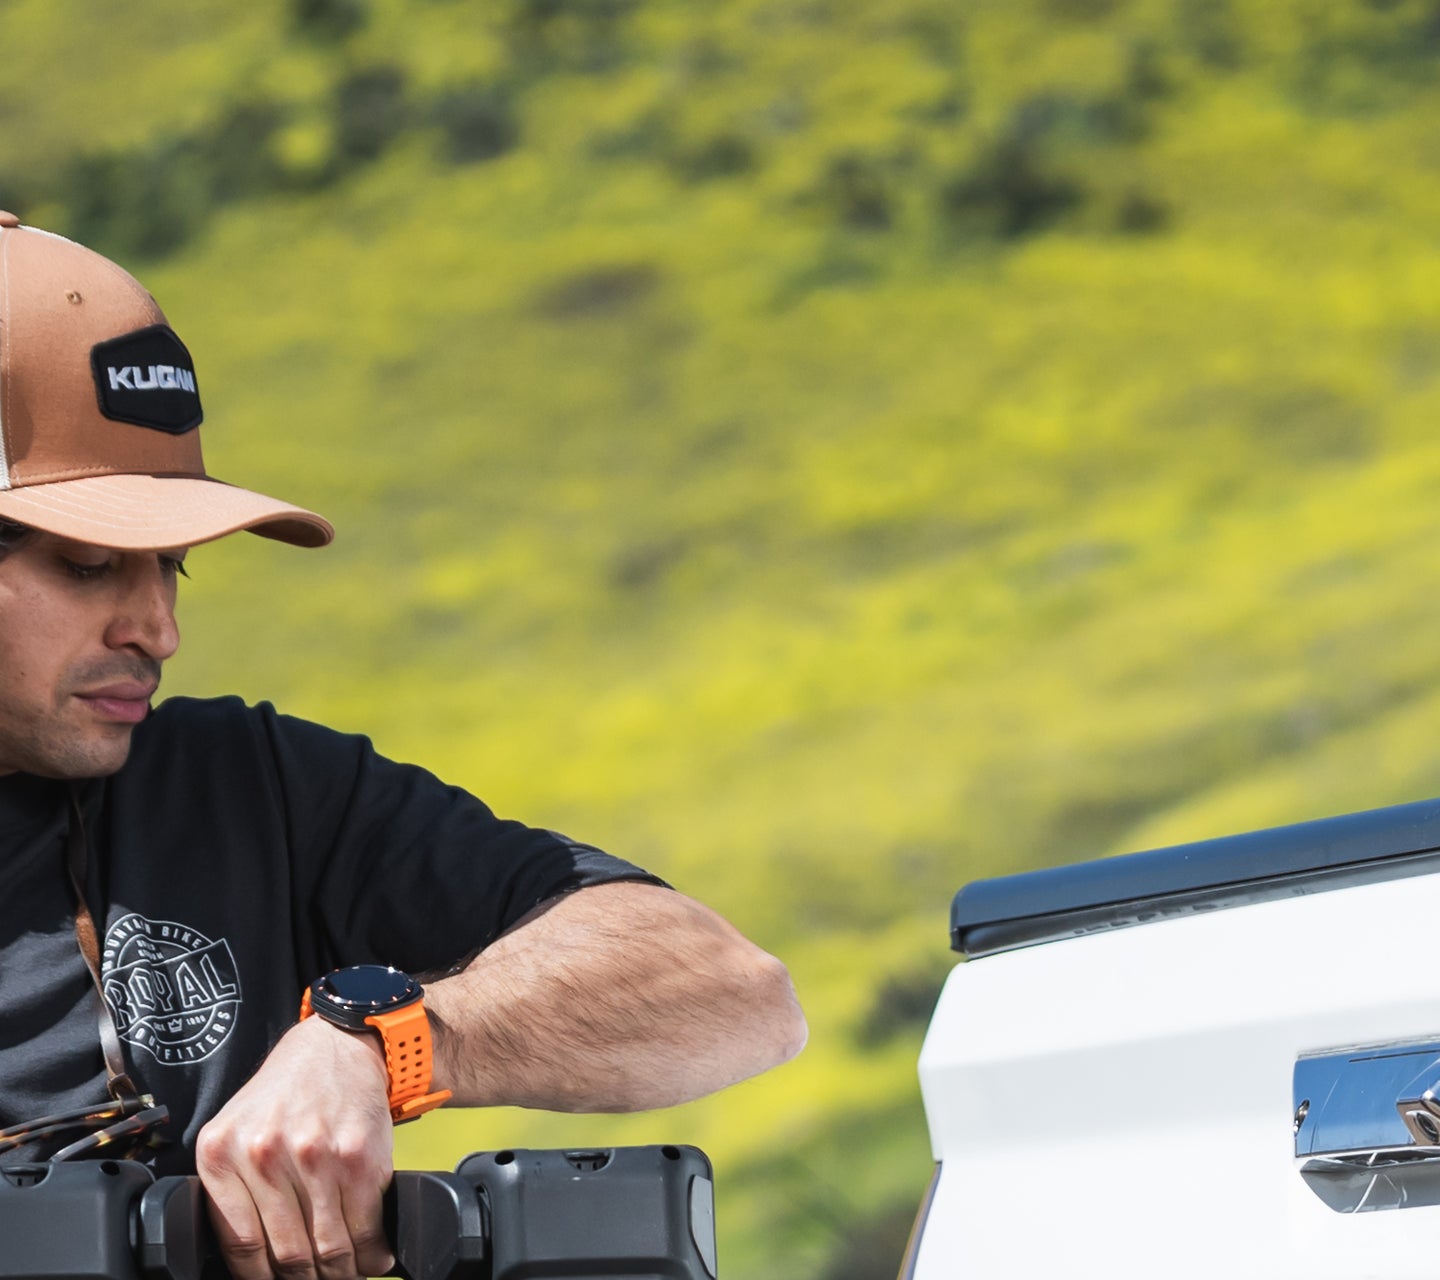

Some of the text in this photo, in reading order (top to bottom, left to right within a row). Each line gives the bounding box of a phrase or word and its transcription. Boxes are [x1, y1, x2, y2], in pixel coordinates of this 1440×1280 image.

[161, 925, 202, 949] BIKE
[103, 953, 237, 1030] ROYAL
[134, 1011, 231, 1060] OUTFITTERS
